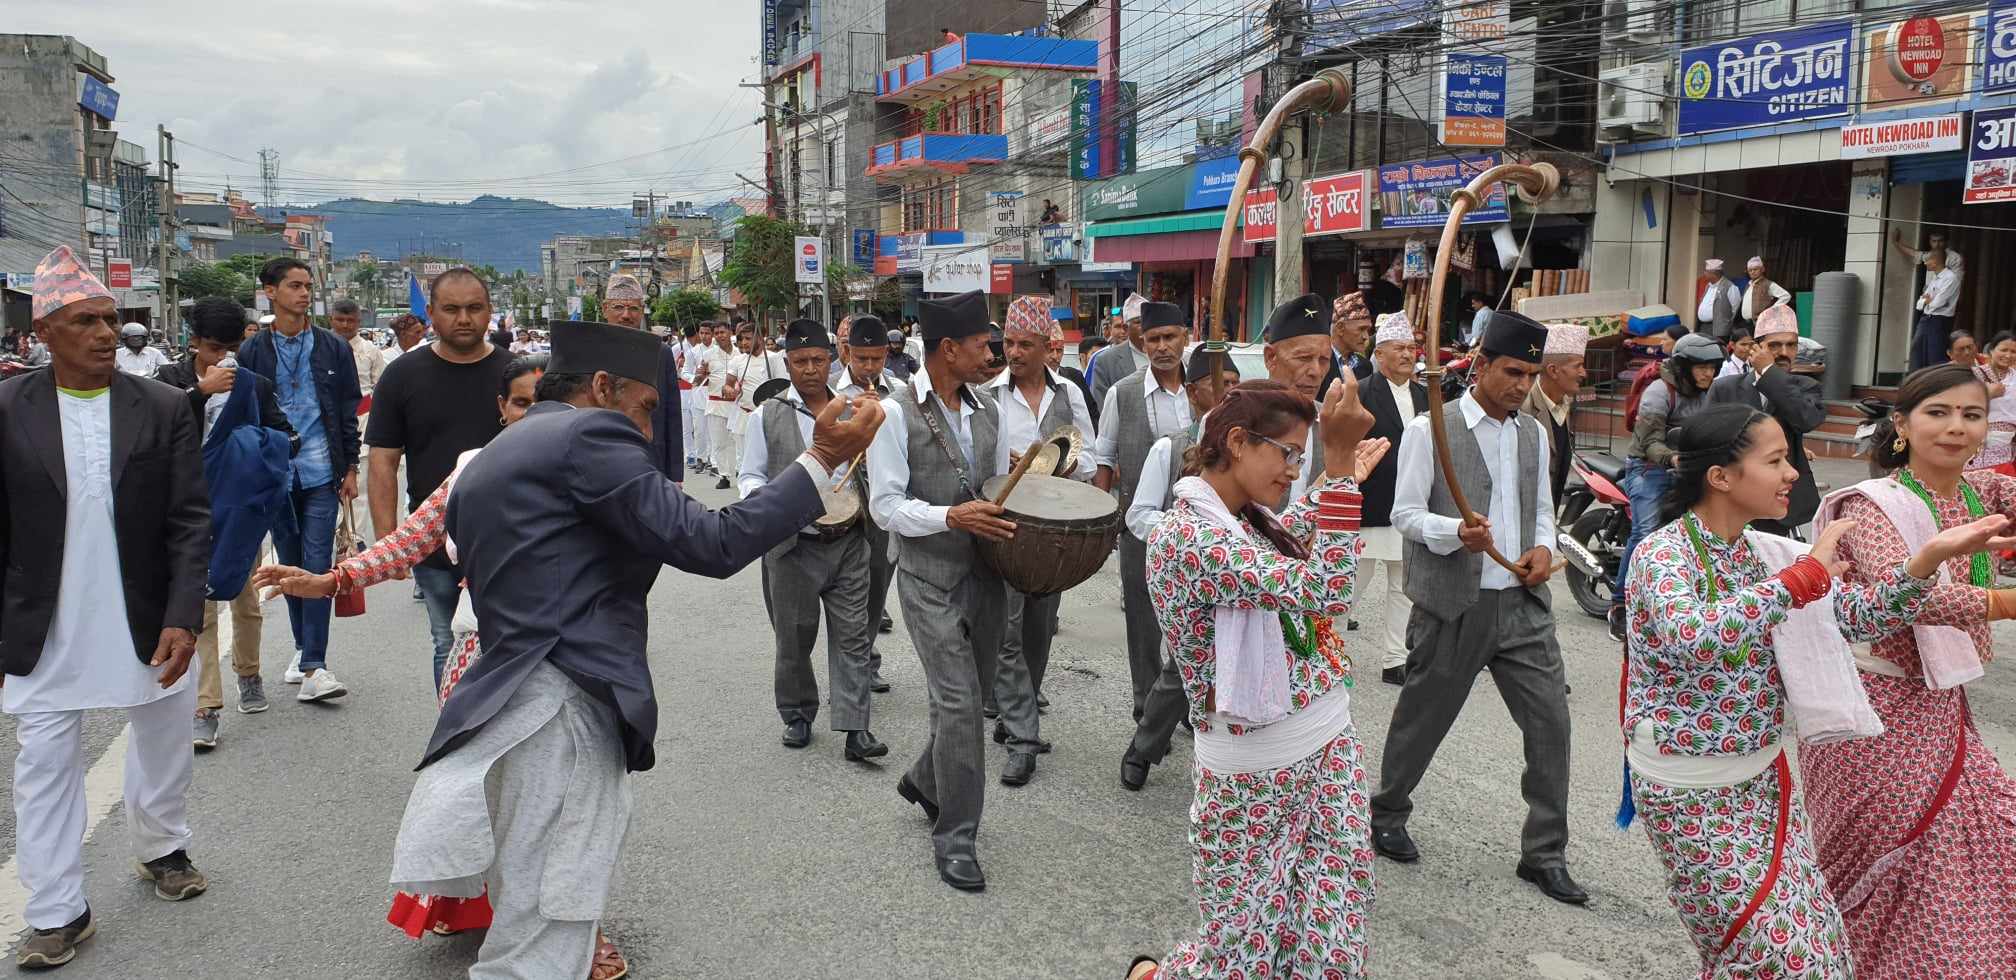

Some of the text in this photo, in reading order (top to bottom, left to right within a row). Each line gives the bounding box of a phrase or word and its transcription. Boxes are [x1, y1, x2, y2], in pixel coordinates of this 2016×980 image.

[1908, 36, 1935, 47] HOTEL
[1901, 49, 1942, 60] NEWROAD
[1717, 39, 1847, 98] सिटिजन
[1913, 63, 1929, 74] INN
[1768, 86, 1844, 115] CITIZEN
[1842, 118, 1959, 147] HOTEL NEWROAD INN
[1867, 141, 1930, 153] NEWROAD POKHARA
[923, 411, 941, 434] FOX
